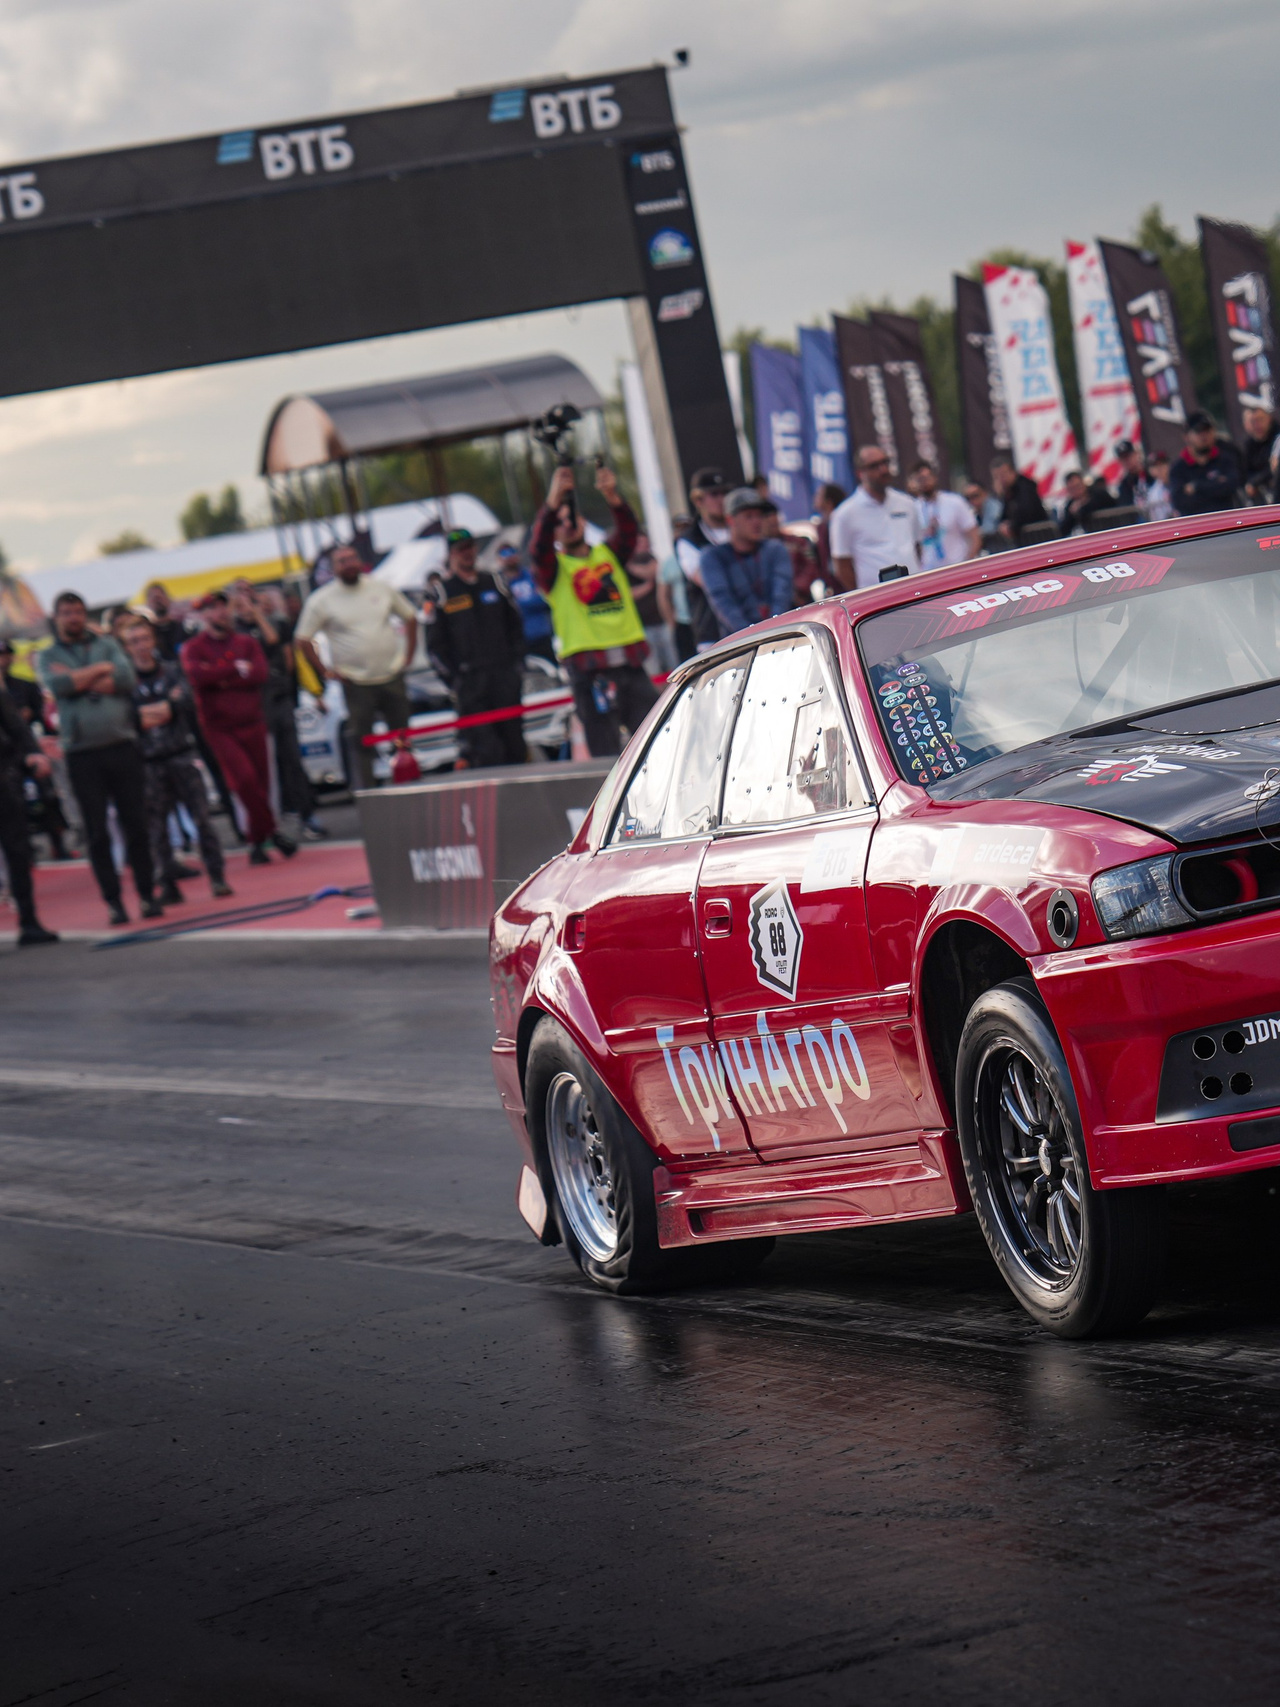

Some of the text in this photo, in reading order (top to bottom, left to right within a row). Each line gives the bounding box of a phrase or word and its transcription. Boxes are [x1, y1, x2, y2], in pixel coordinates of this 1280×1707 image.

[530, 85, 621, 138] ВТБ
[259, 125, 353, 181] ВТБ
[946, 562, 1136, 617] RDRC 88
[973, 839, 1036, 865] ardeca
[764, 907, 778, 919] RDRC
[769, 922, 787, 957] 88
[656, 1010, 871, 1152] ГринАгро
